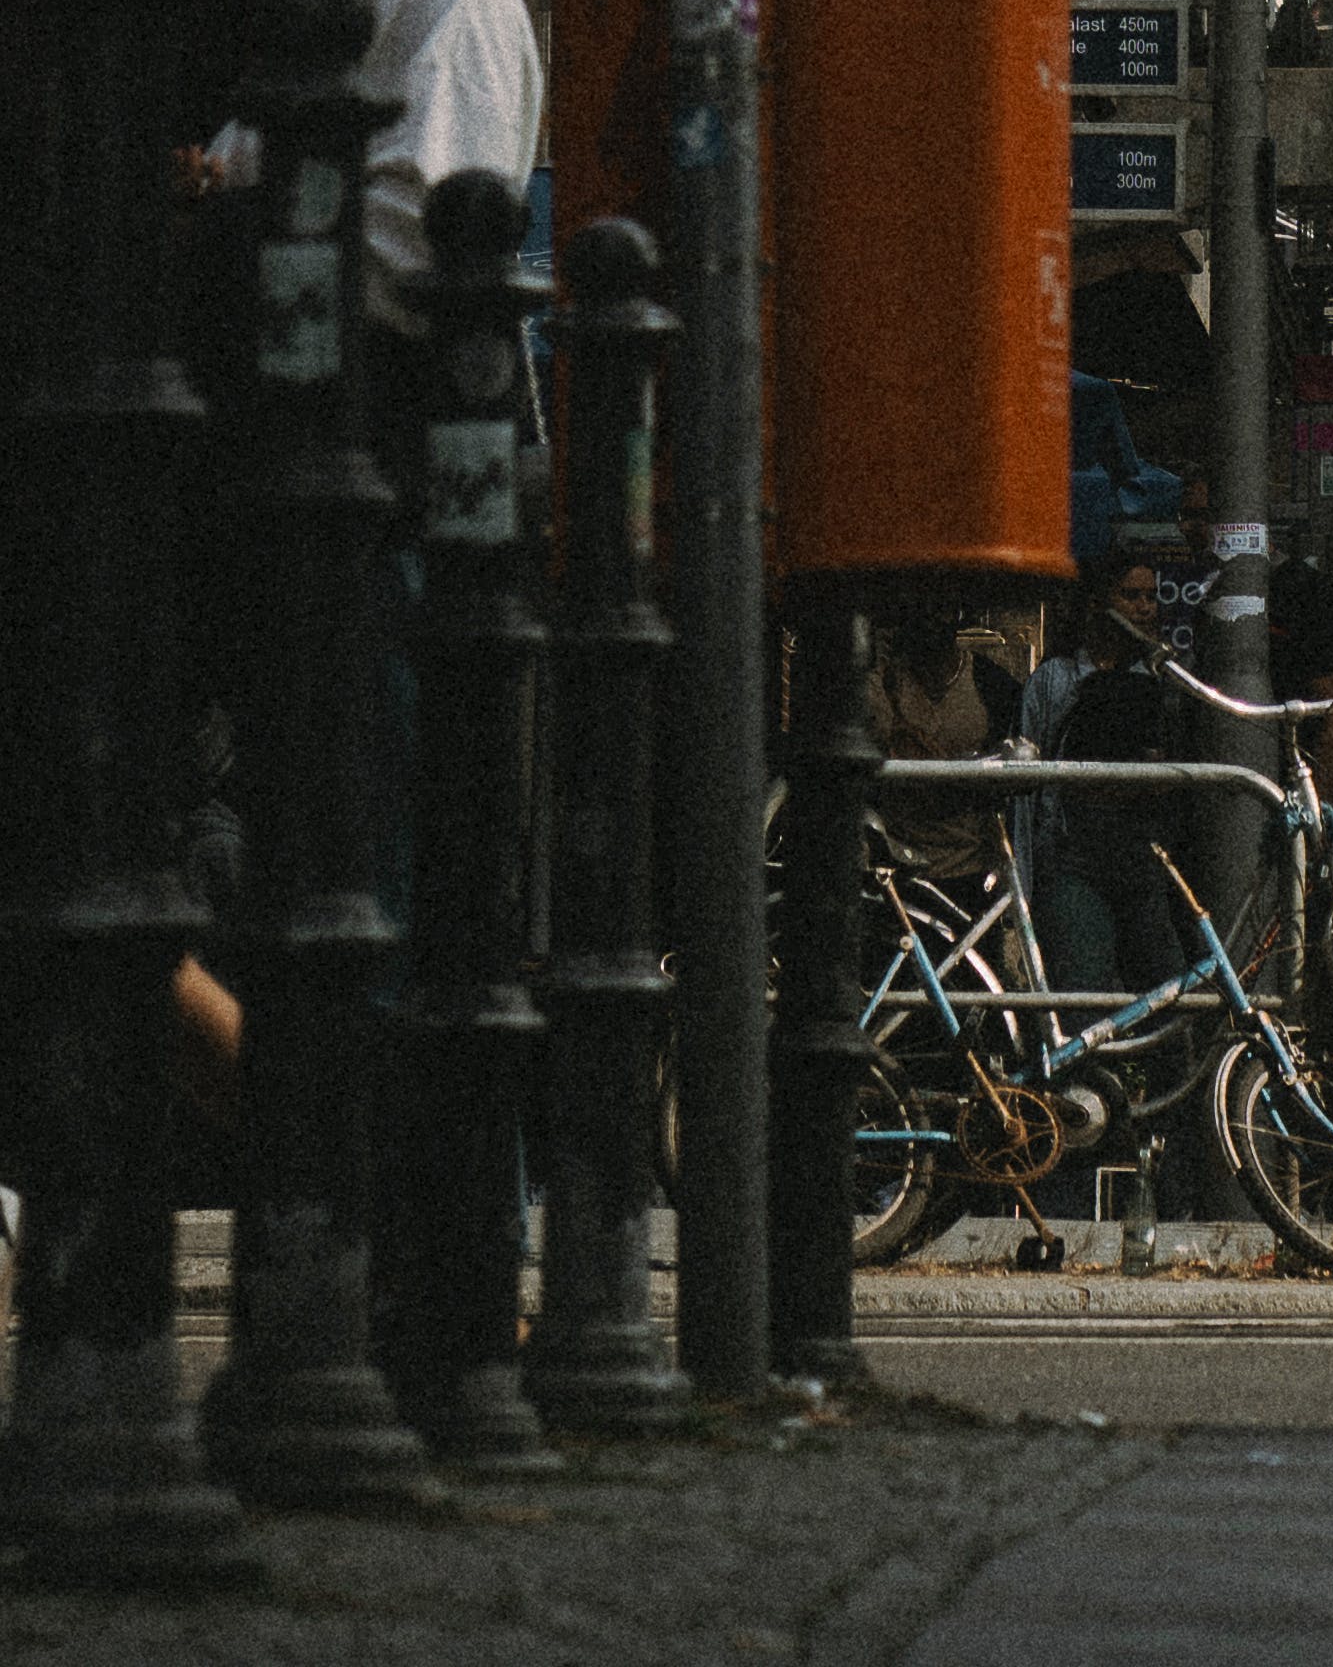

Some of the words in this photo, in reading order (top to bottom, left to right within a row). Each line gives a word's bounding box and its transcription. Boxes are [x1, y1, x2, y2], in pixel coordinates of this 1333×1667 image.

[1119, 16, 1159, 32] 450m
[1118, 38, 1159, 54] 400m
[1120, 61, 1159, 76] 100m
[1119, 151, 1157, 167] 100m
[1116, 173, 1156, 189] 300m
